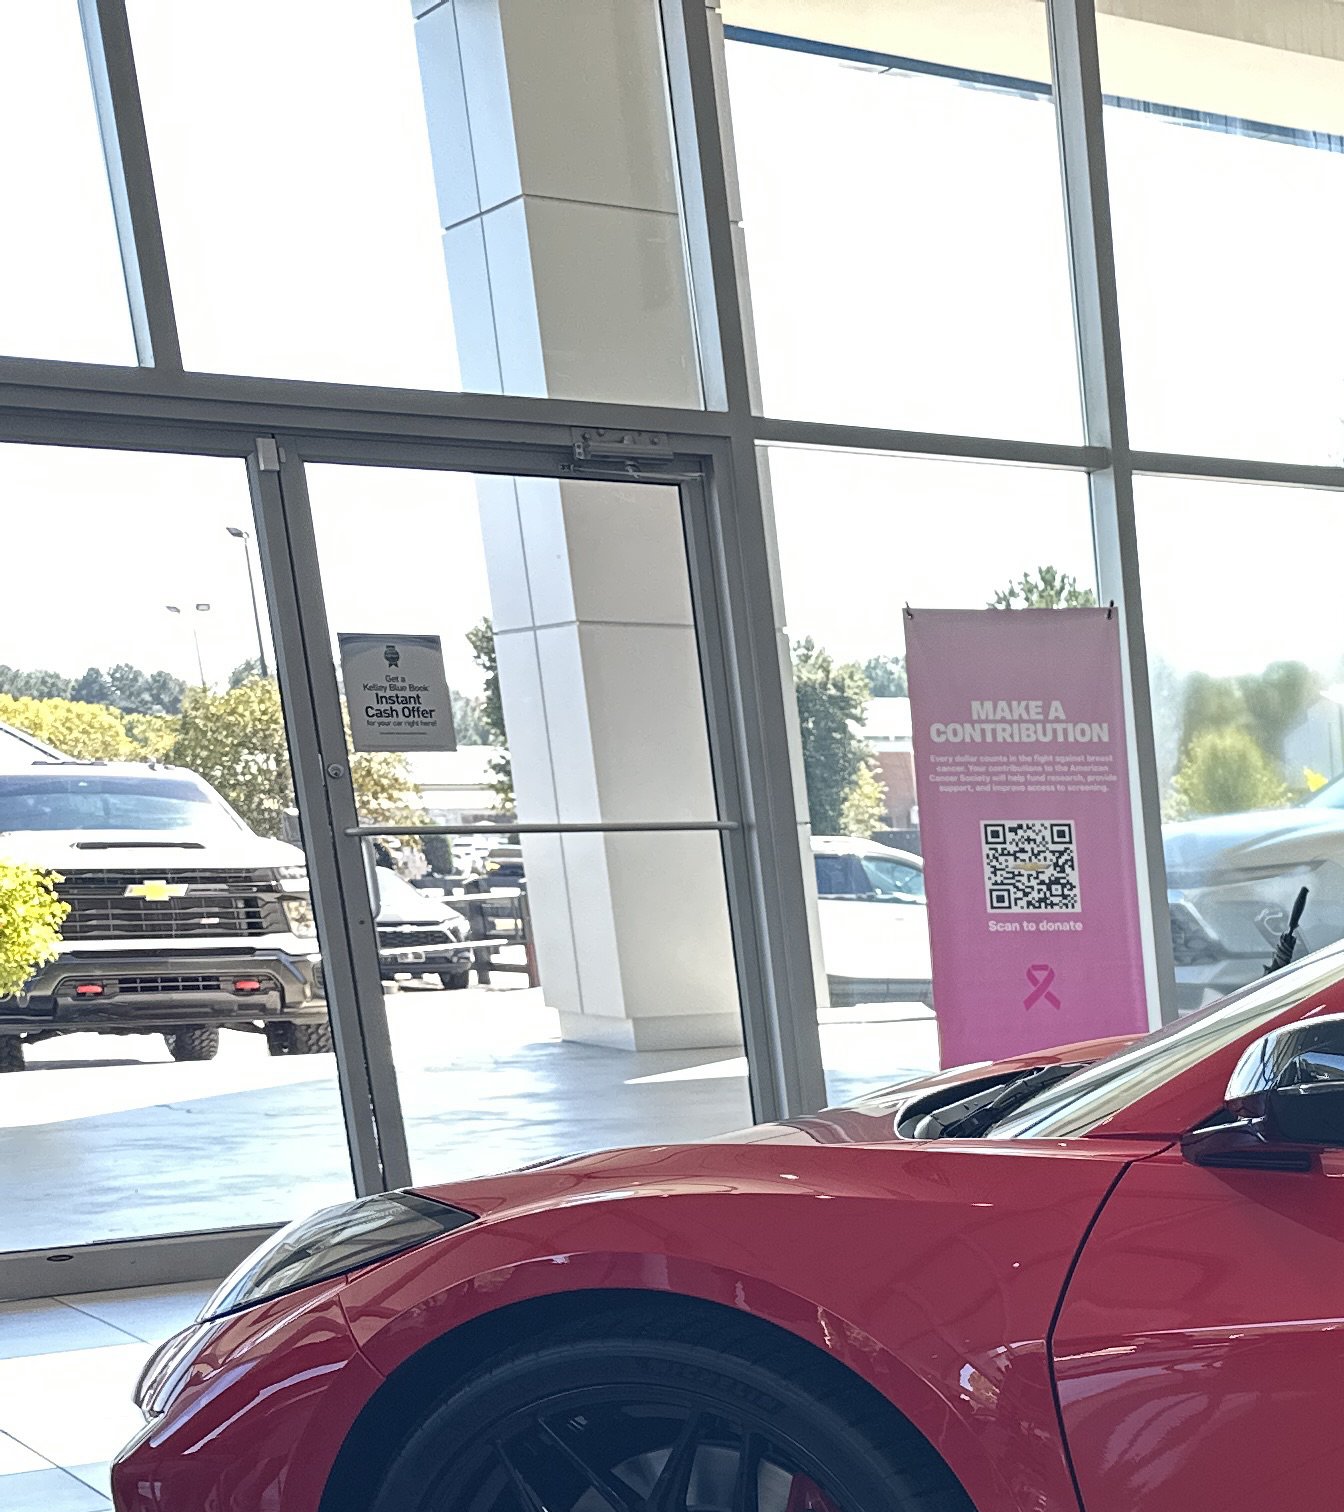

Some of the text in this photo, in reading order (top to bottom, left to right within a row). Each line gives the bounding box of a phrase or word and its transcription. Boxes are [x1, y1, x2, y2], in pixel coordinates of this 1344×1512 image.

[385, 675, 400, 683] Get
[363, 683, 388, 693] Kelley
[389, 683, 407, 692] Blue
[375, 692, 422, 705] Instant
[365, 705, 436, 719] Cash Offer
[971, 700, 1066, 721] MAKE A
[929, 722, 1110, 743] CONTRIBUTION
[988, 920, 1083, 932] Scan to donate
